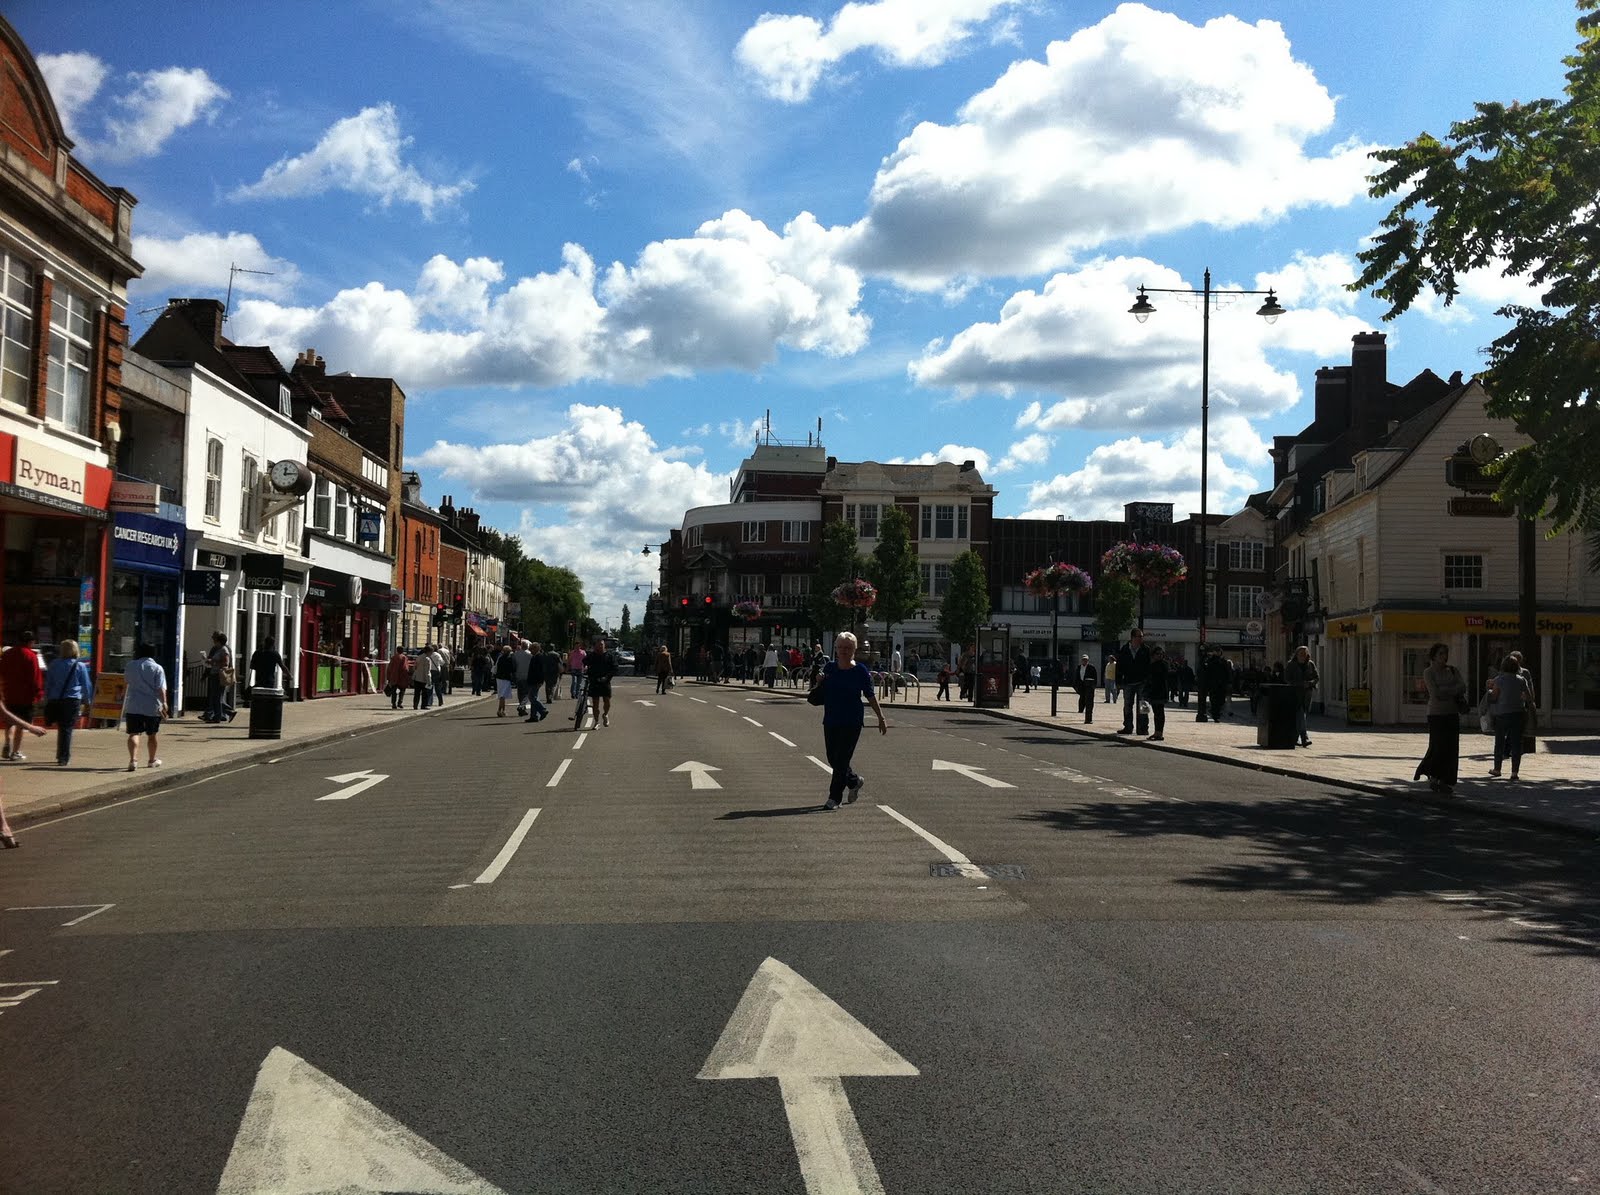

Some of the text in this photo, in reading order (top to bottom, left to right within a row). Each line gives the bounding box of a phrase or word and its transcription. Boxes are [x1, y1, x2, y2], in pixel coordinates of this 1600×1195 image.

[19, 458, 82, 495] Ryman
[18, 488, 36, 500] the
[38, 495, 83, 513] stationer
[112, 491, 154, 500] Ryman
[114, 526, 174, 549] CANCER RESEARCH UK
[247, 576, 281, 588] PREZZO
[1466, 616, 1573, 632] The Mon Shop
